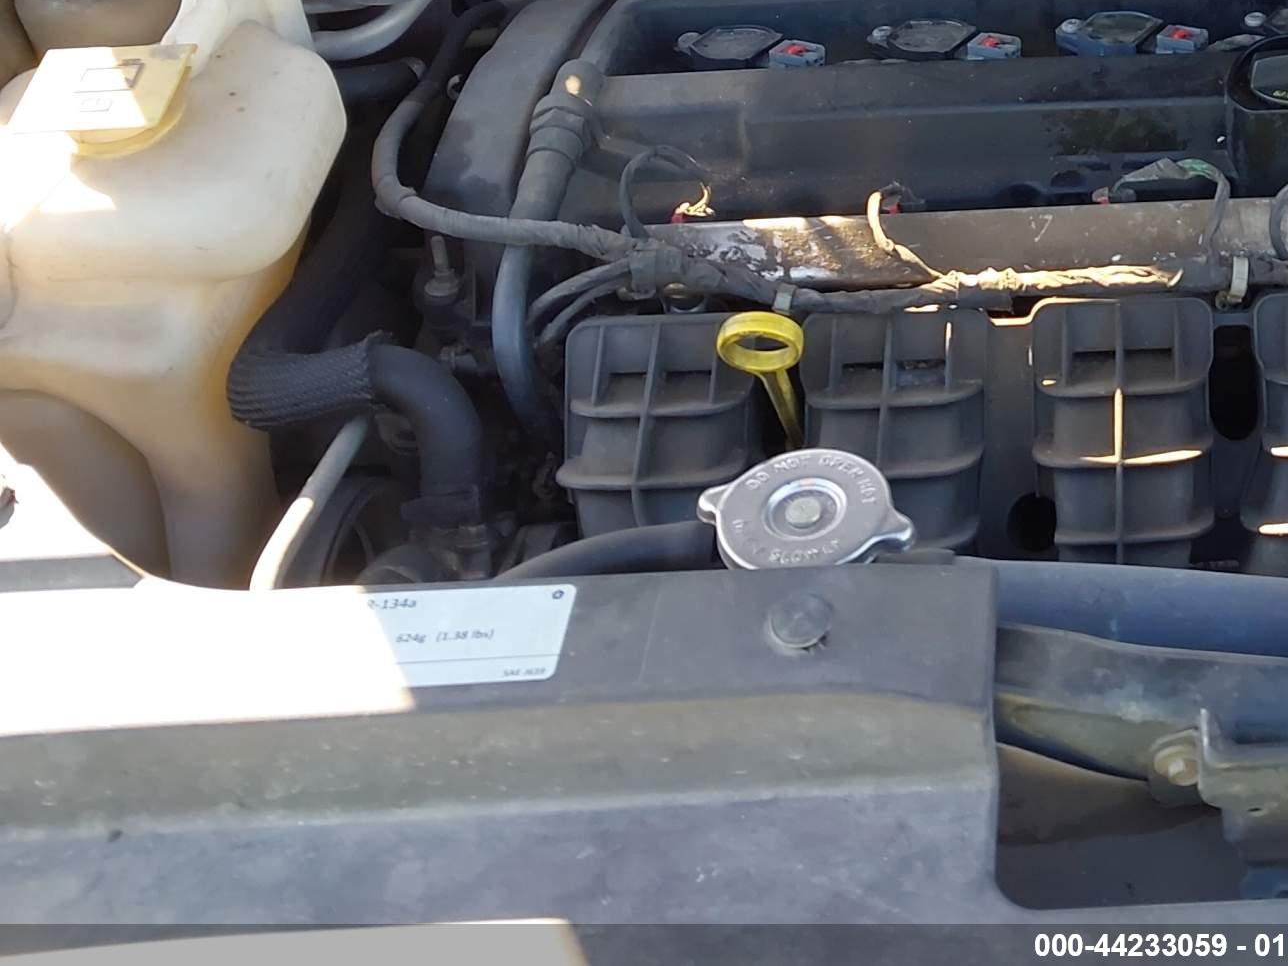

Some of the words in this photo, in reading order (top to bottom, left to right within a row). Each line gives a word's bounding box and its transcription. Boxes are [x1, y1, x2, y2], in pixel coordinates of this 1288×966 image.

[745, 471, 770, 490] DO
[773, 455, 811, 472] NOT
[819, 454, 865, 478] OPEN
